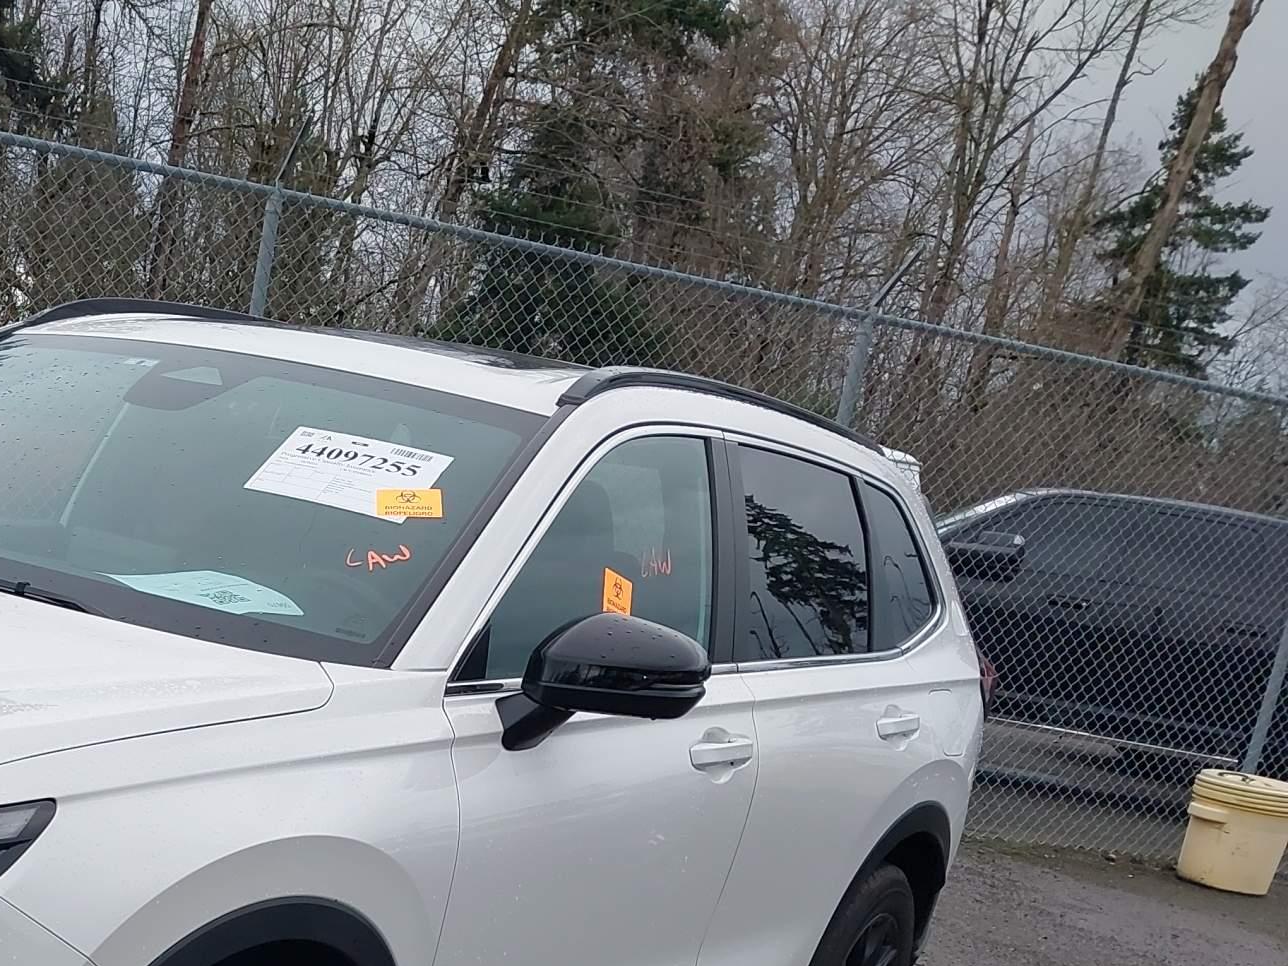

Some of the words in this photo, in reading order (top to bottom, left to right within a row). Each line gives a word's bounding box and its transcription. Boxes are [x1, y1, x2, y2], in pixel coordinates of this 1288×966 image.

[295, 443, 421, 478] 44097255
[345, 545, 411, 572] LAW
[640, 547, 672, 578] LAW
